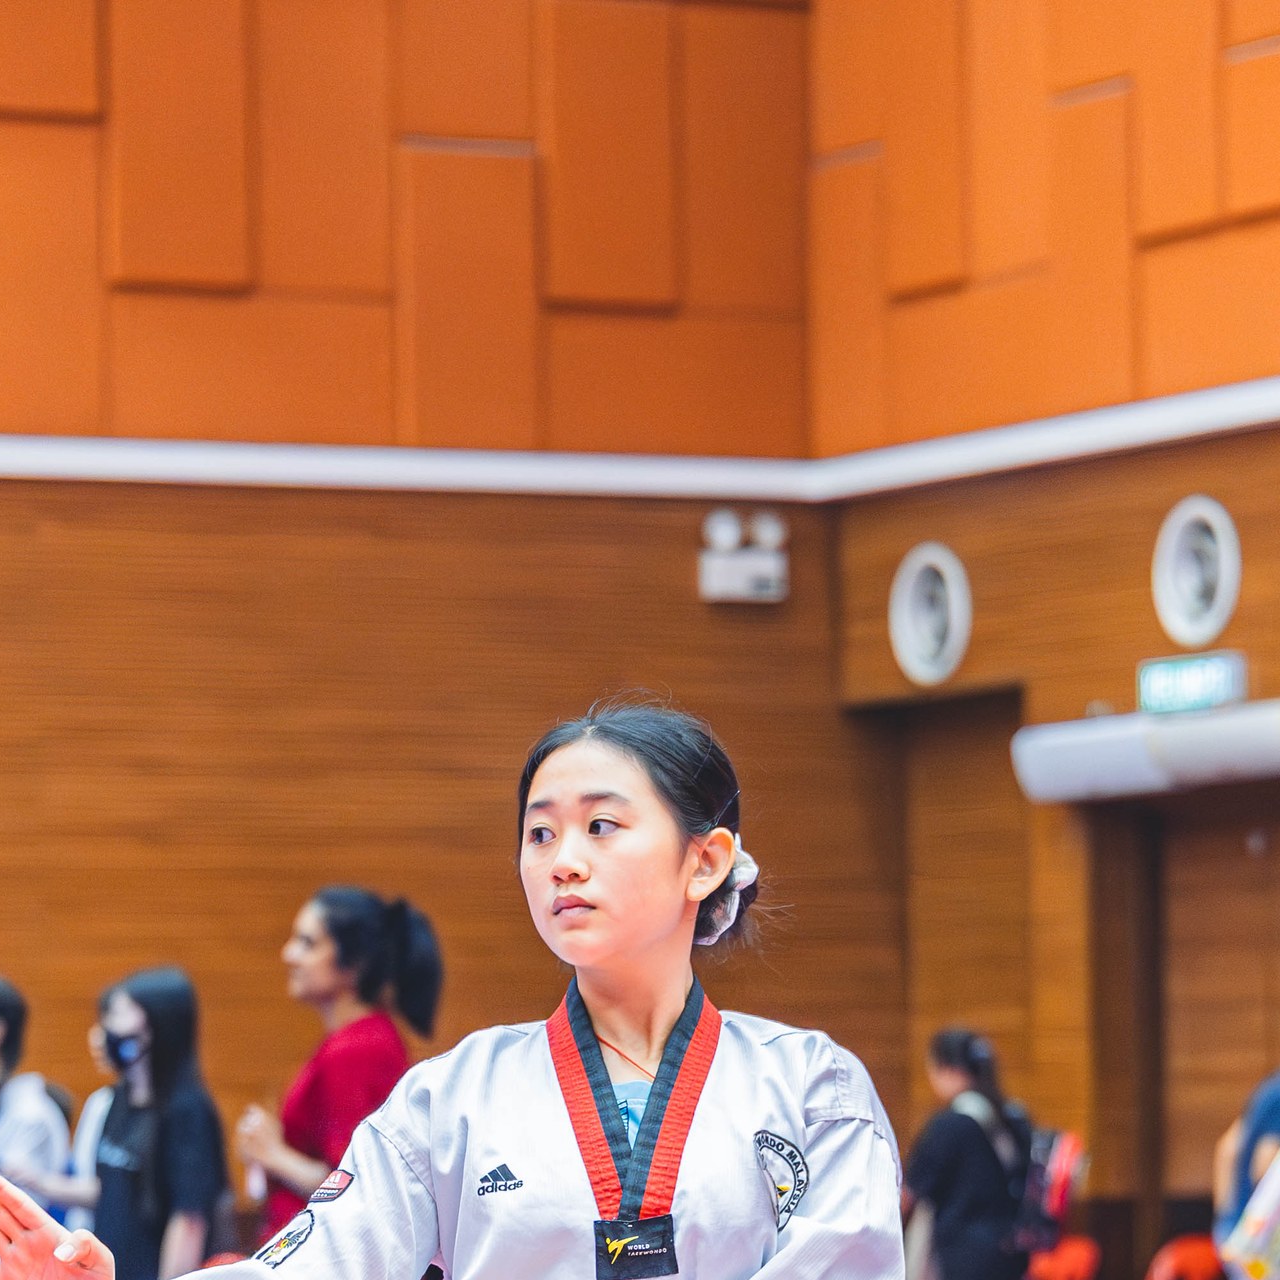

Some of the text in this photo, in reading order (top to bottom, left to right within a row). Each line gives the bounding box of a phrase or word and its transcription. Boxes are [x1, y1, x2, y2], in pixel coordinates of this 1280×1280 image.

[477, 1179, 523, 1196] adidas
[785, 1150, 805, 1214] MALAYSIA
[627, 1247, 667, 1256] TAEKWONDO
